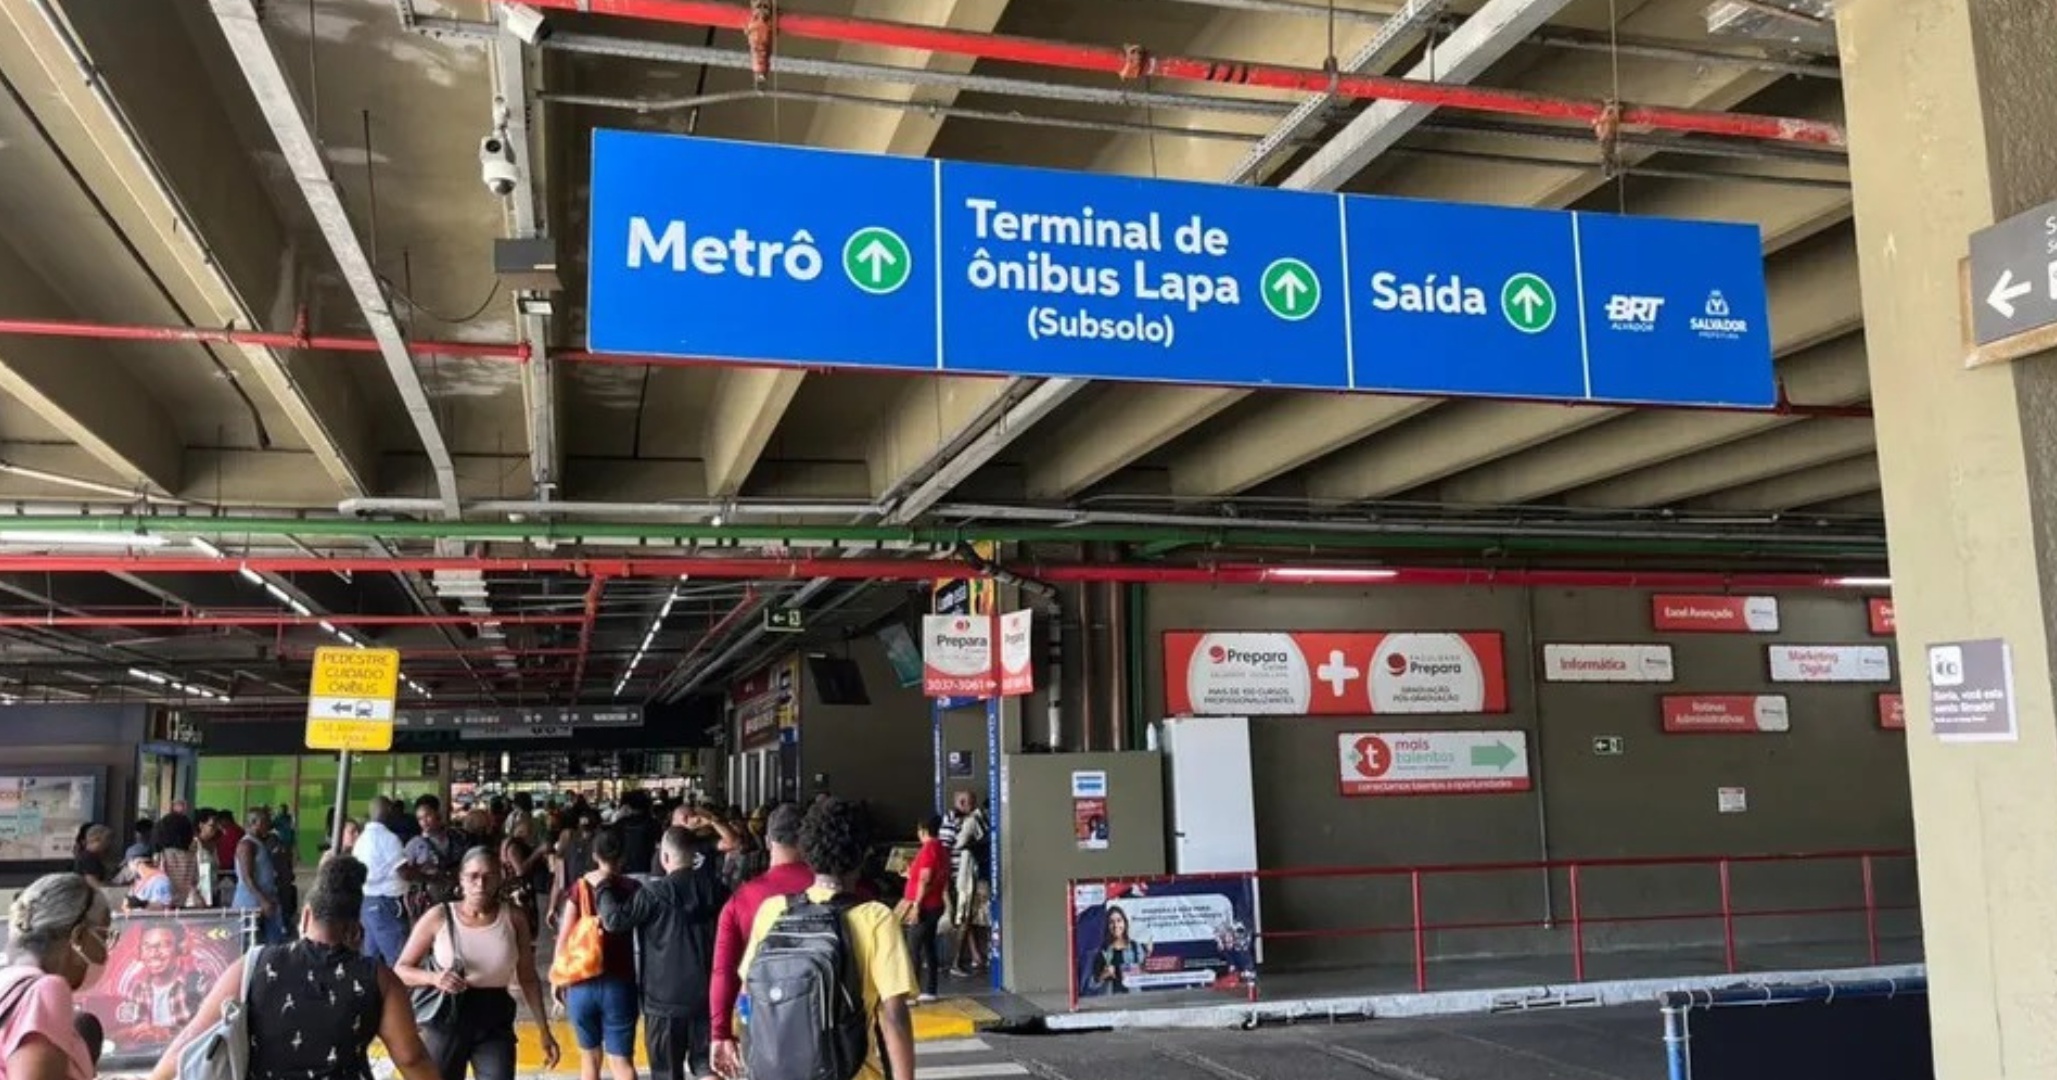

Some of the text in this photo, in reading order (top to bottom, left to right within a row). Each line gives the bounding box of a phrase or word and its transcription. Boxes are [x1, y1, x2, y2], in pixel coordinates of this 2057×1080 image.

[965, 199, 1228, 255] Terminal de
[626, 217, 823, 281] Metrô
[967, 249, 1240, 311] ônibus Lapa
[1372, 272, 1487, 315] Saída
[1604, 294, 1665, 322] BRT
[1027, 307, 1174, 348] (Subsolo)
[1690, 317, 1747, 332] SALVADOR
[1690, 606, 1734, 619] Avançado
[937, 634, 987, 649] Prepara
[323, 653, 391, 666] PEDESTRE
[1228, 649, 1287, 665] Prepara
[1560, 657, 1626, 670] Informática
[1788, 650, 1838, 664] Marketing
[325, 667, 384, 679] CUIDADO
[1410, 662, 1461, 676] Prepara
[1799, 663, 1831, 676] Digital
[1395, 739, 1429, 749] mais
[1396, 751, 1454, 763] talentos
